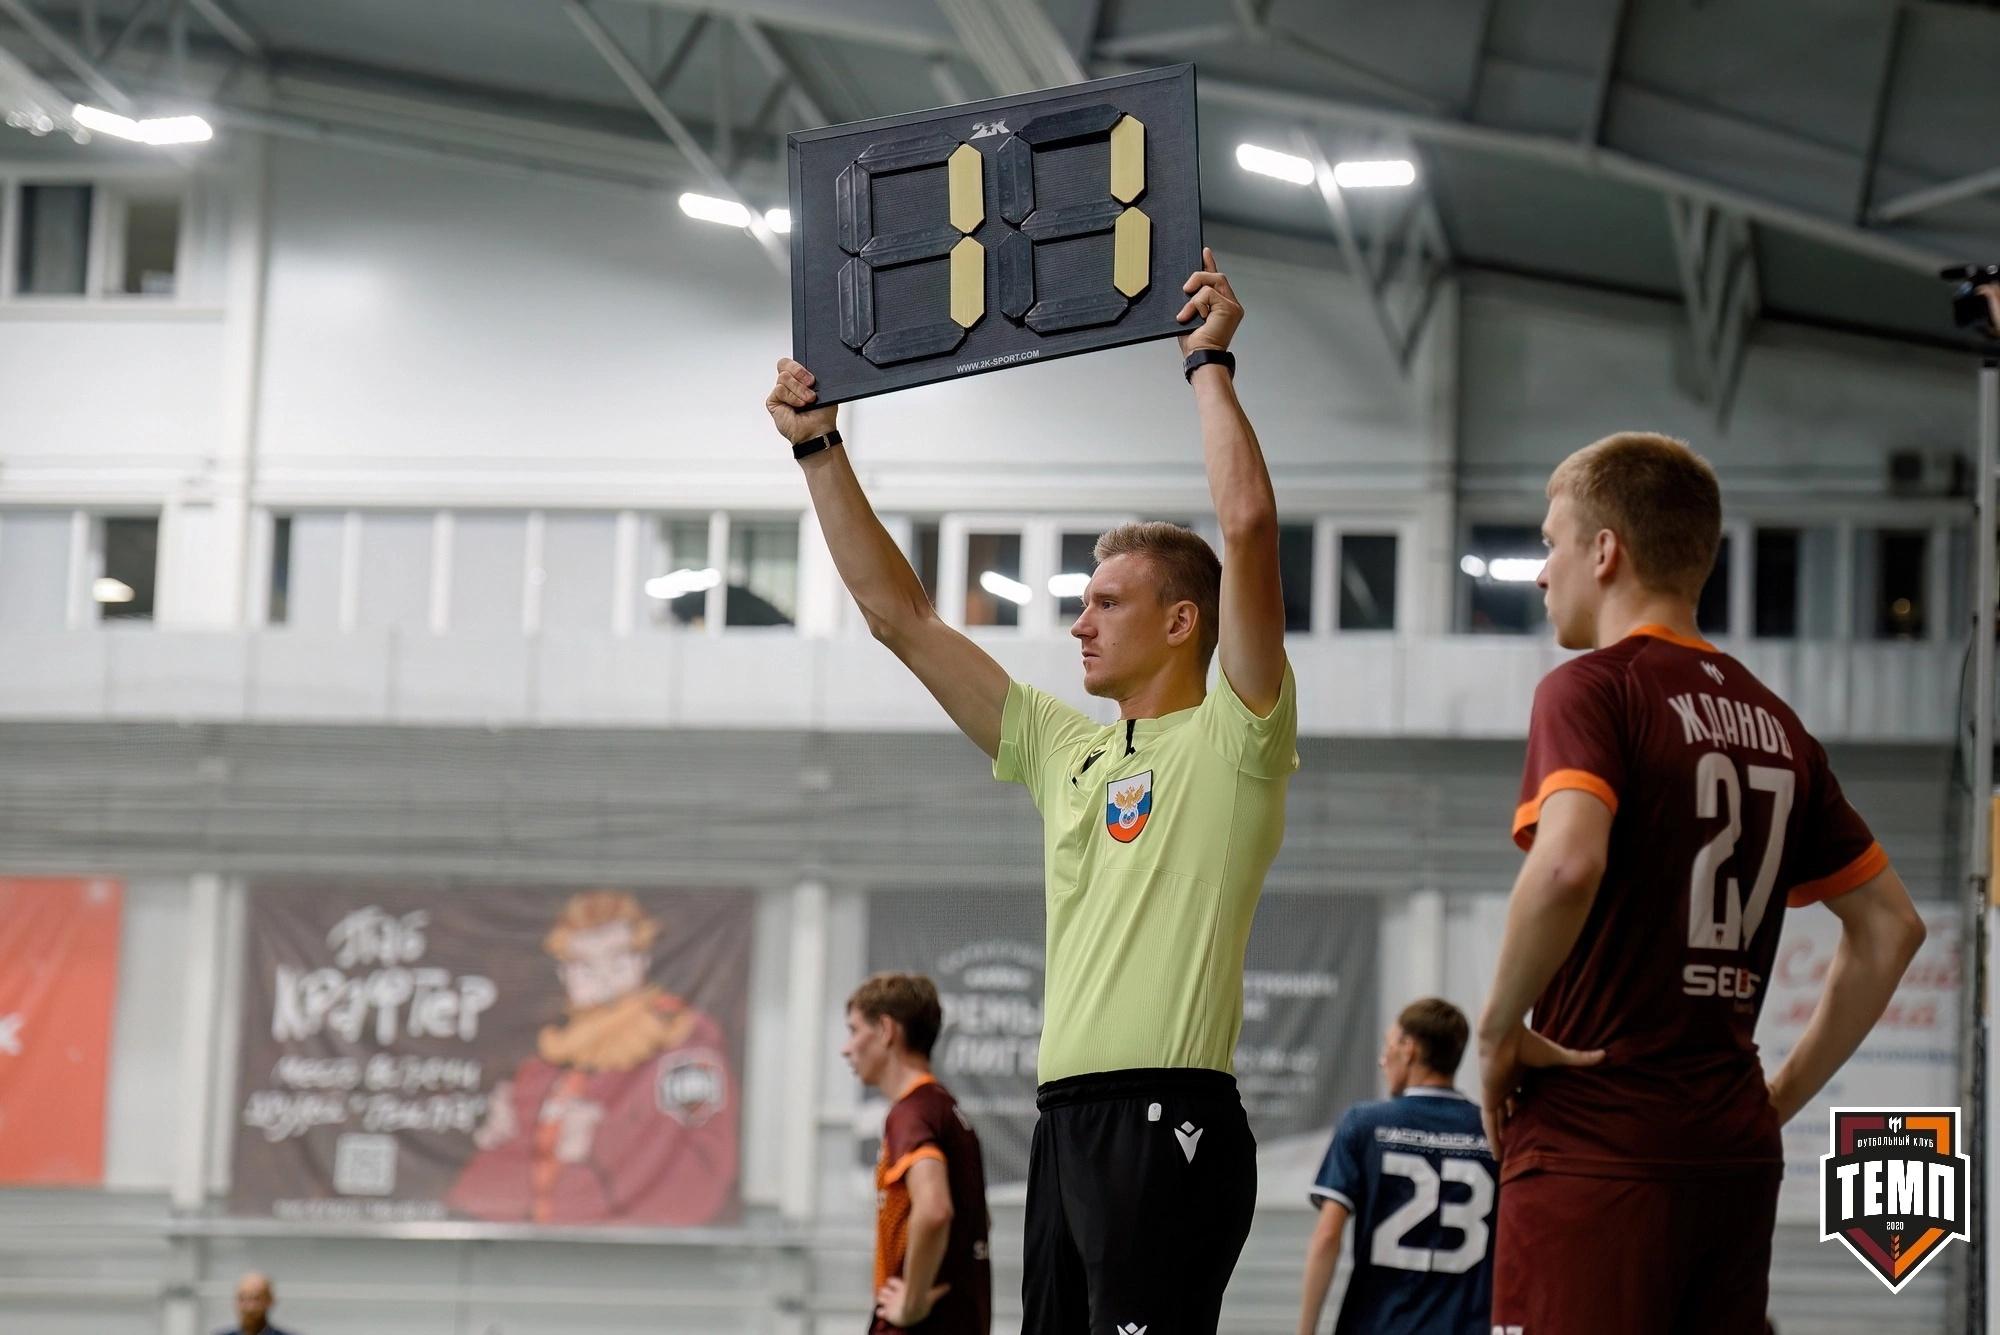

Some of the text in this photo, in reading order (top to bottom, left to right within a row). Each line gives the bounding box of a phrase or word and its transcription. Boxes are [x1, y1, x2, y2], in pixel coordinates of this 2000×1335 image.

[969, 118, 1010, 140] 2K
[948, 115, 1150, 328] 11
[956, 349, 1040, 373] WWW.2K-SPORT.COM
[1667, 692, 1794, 761] ЖДАНОВ
[1688, 752, 1796, 952] 27
[1370, 1151, 1496, 1274] 23
